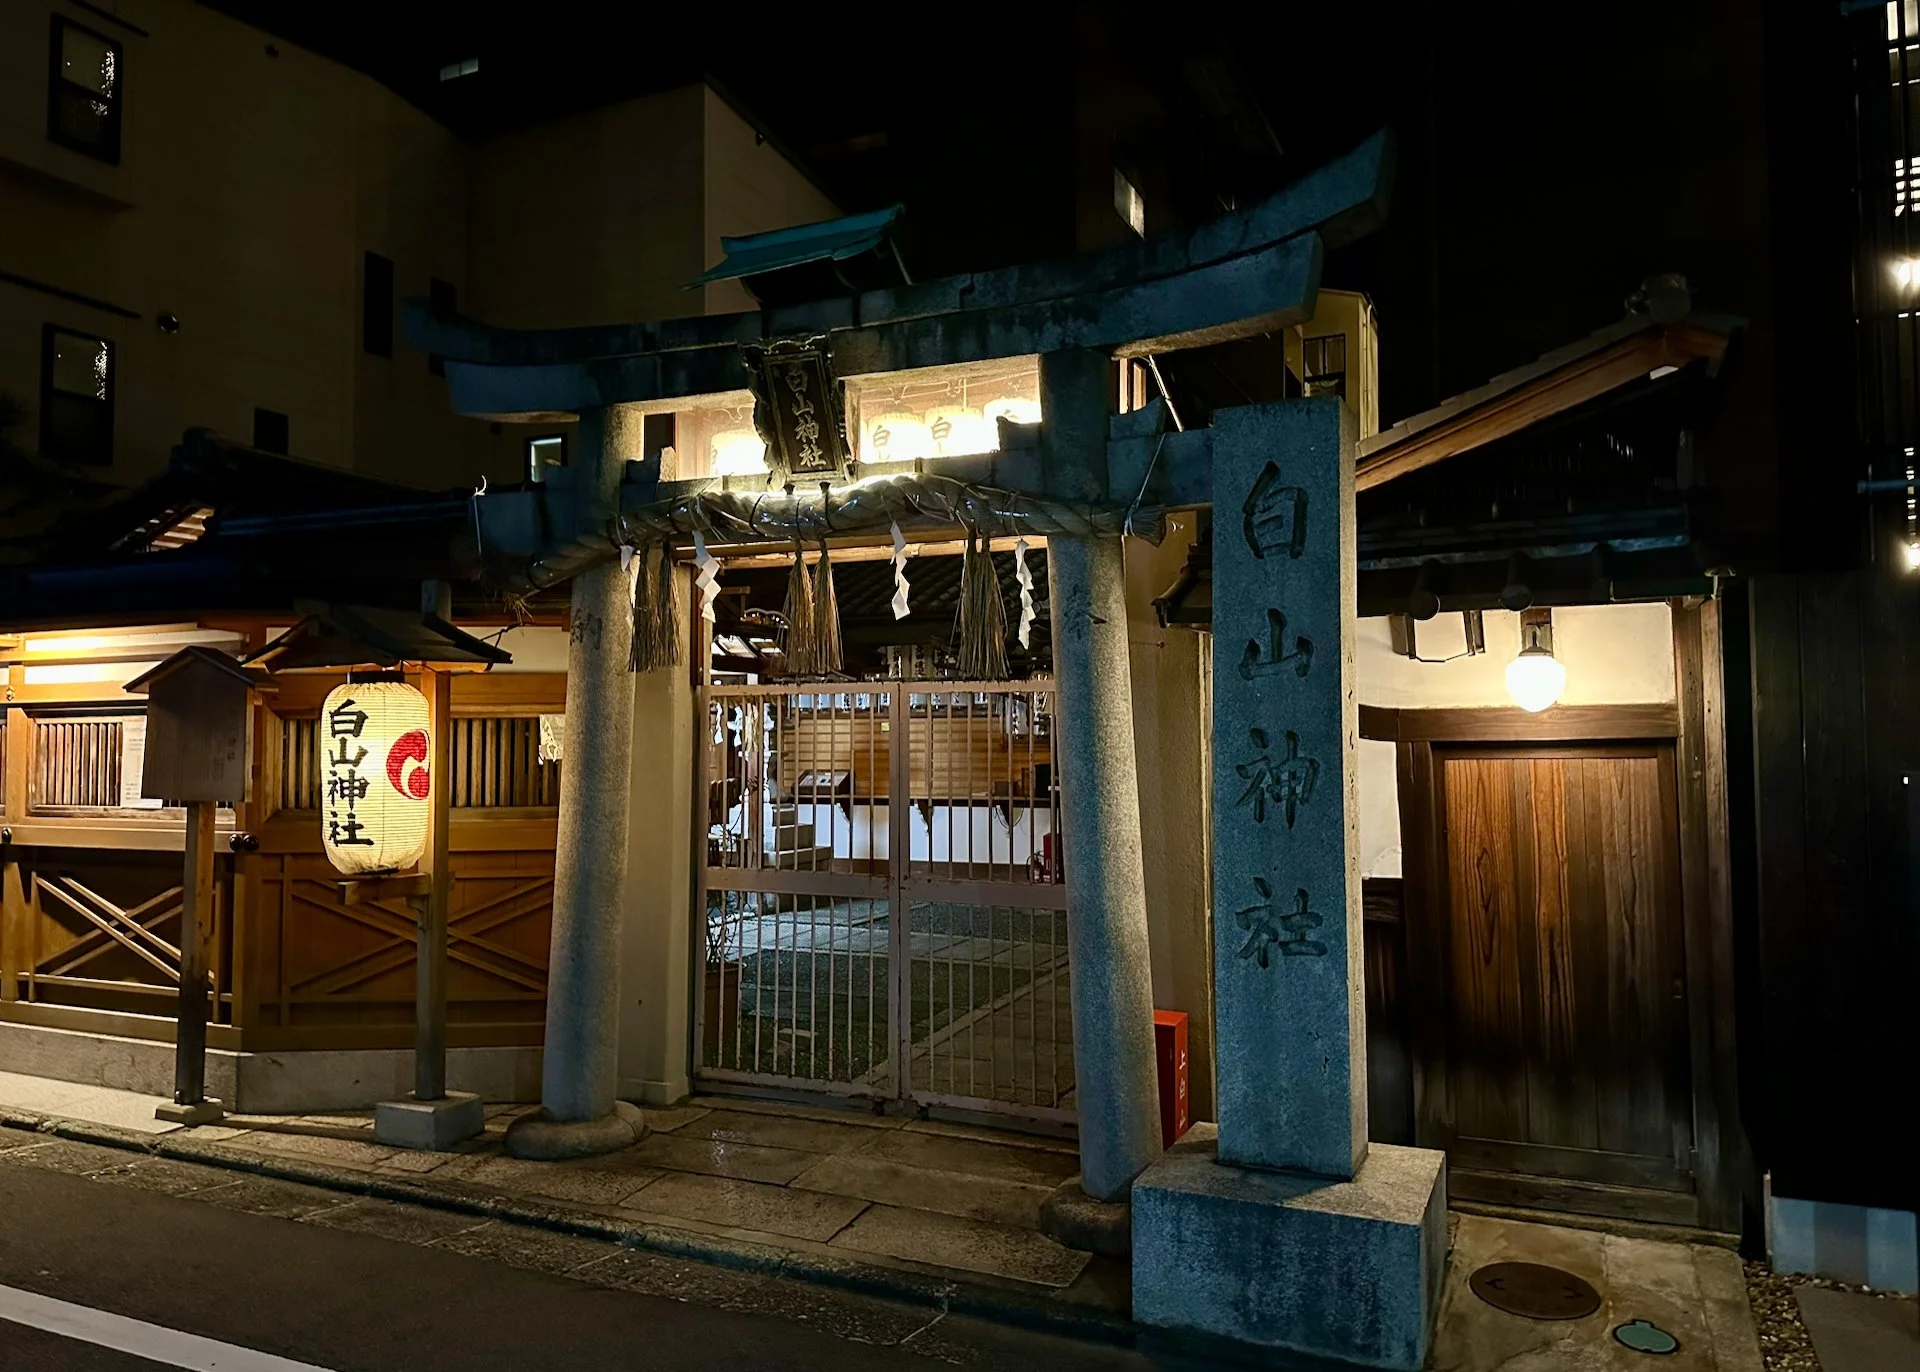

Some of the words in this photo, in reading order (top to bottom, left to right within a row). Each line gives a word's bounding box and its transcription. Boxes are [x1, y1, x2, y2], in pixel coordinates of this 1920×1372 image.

[785, 366, 826, 467] 白山神社
[327, 698, 375, 848] 白山神社
[1234, 460, 1328, 969] 白山神社
